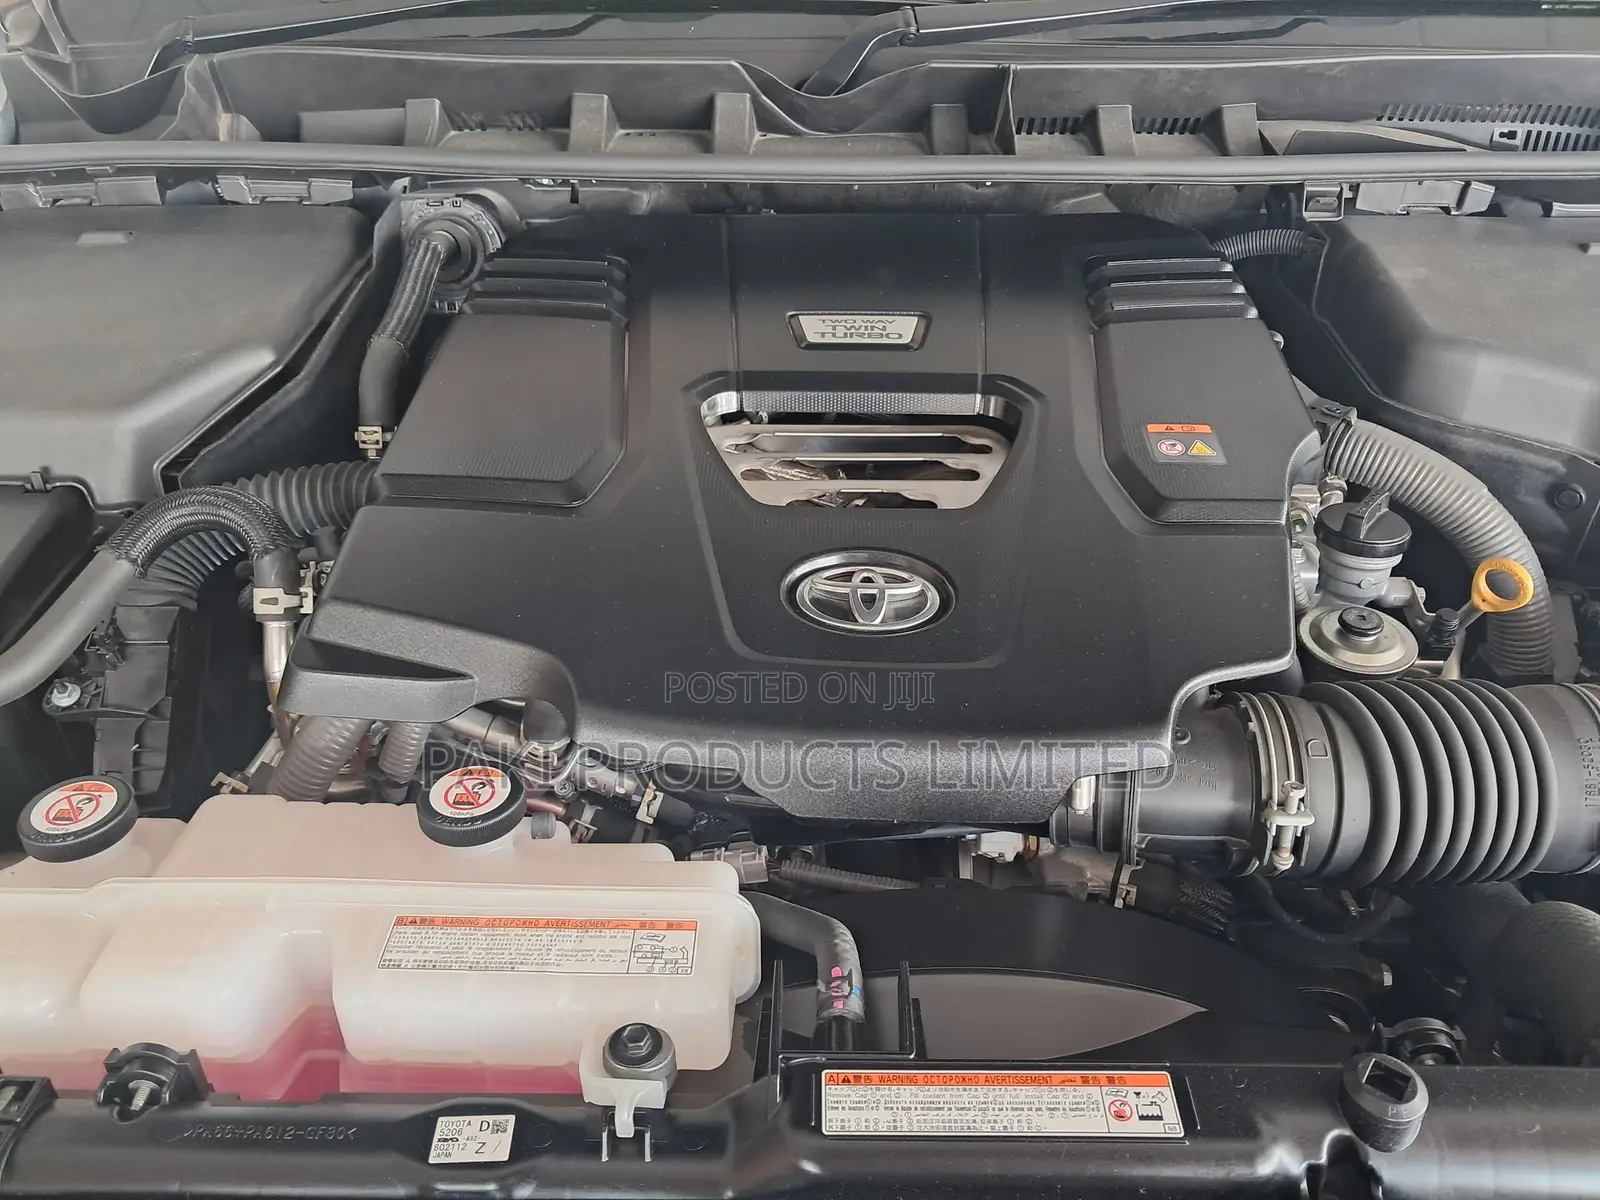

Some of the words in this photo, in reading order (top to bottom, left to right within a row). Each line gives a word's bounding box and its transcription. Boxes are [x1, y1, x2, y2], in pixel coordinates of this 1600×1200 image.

[544, 920, 611, 928] AVERTISSEMENT
[828, 1075, 836, 1083] A
[853, 1075, 873, 1083] 警告
[878, 1075, 918, 1084] WARNING
[984, 1075, 1052, 1085] AVERTISSEMENT
[440, 1120, 472, 1128] TOYOTA
[479, 1120, 490, 1132] D
[439, 1128, 463, 1136] 5206
[433, 1142, 467, 1151] 802112
[475, 1142, 486, 1154] Z
